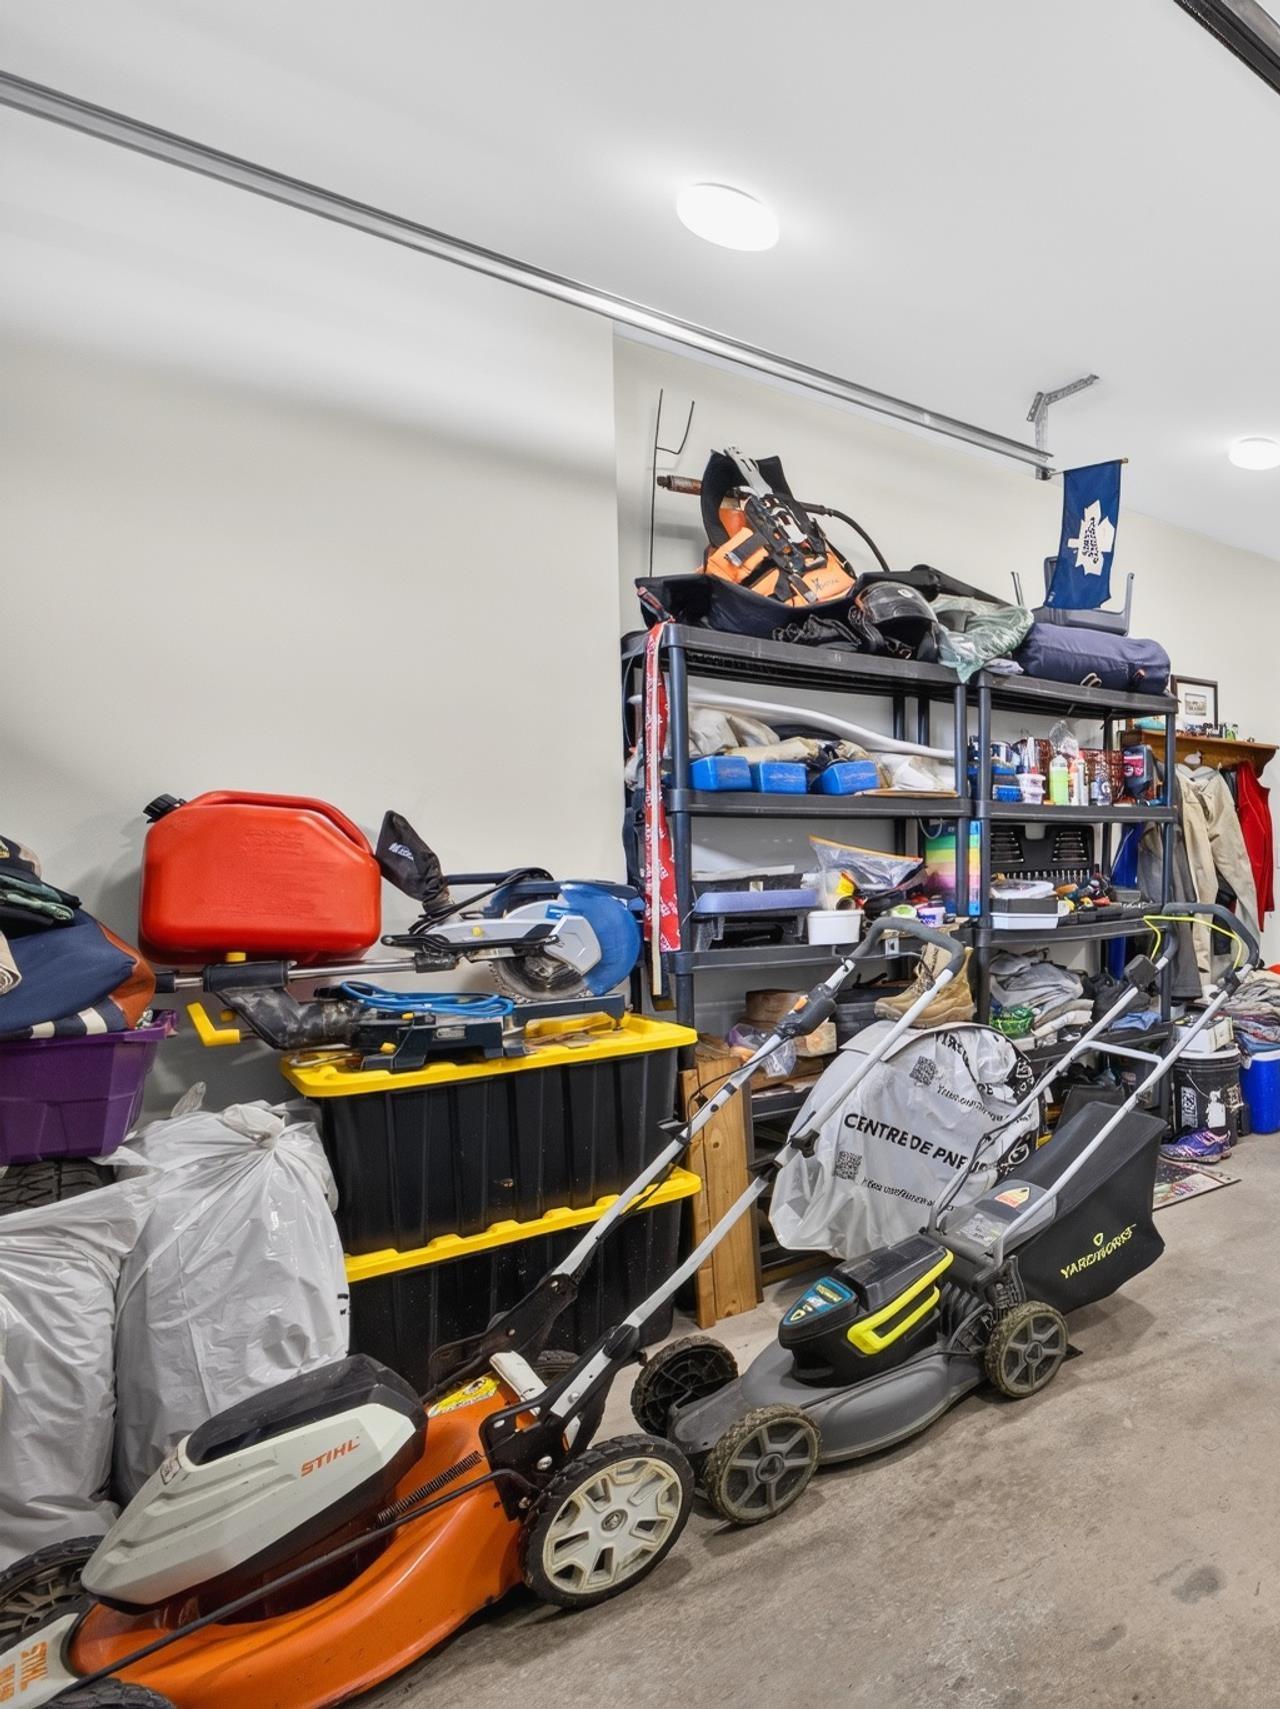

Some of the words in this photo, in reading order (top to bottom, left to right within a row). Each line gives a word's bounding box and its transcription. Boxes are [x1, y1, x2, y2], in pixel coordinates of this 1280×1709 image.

[844, 1113, 908, 1147] CENTRE
[909, 1135, 934, 1155] DE
[301, 1439, 360, 1477] STIHL
